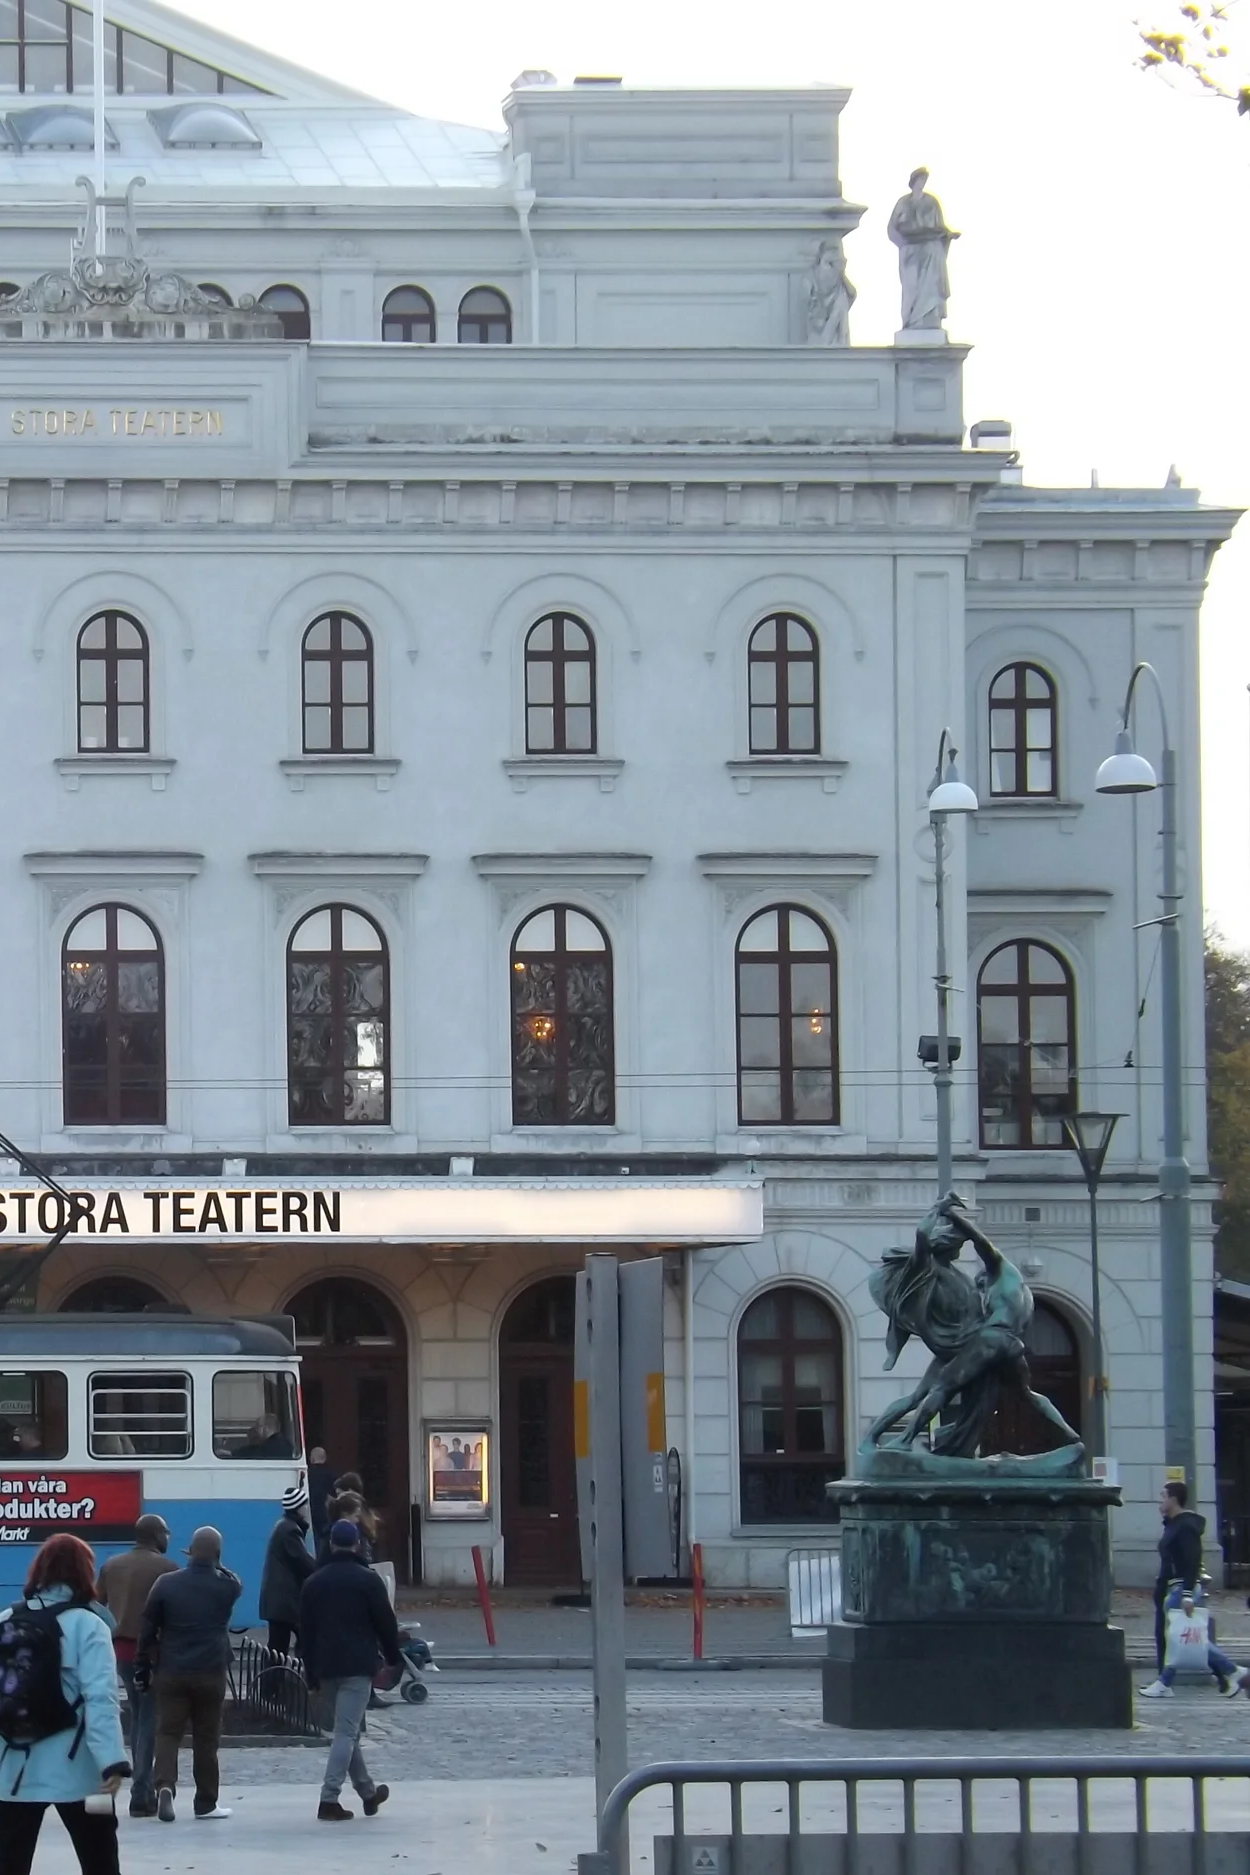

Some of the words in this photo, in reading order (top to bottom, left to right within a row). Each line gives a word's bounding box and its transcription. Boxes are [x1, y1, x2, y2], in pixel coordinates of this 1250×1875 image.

[11, 410, 97, 436] STORA
[109, 410, 223, 436] TEATERN
[143, 1191, 341, 1233] TEATERN
[28, 1475, 67, 1494] våra
